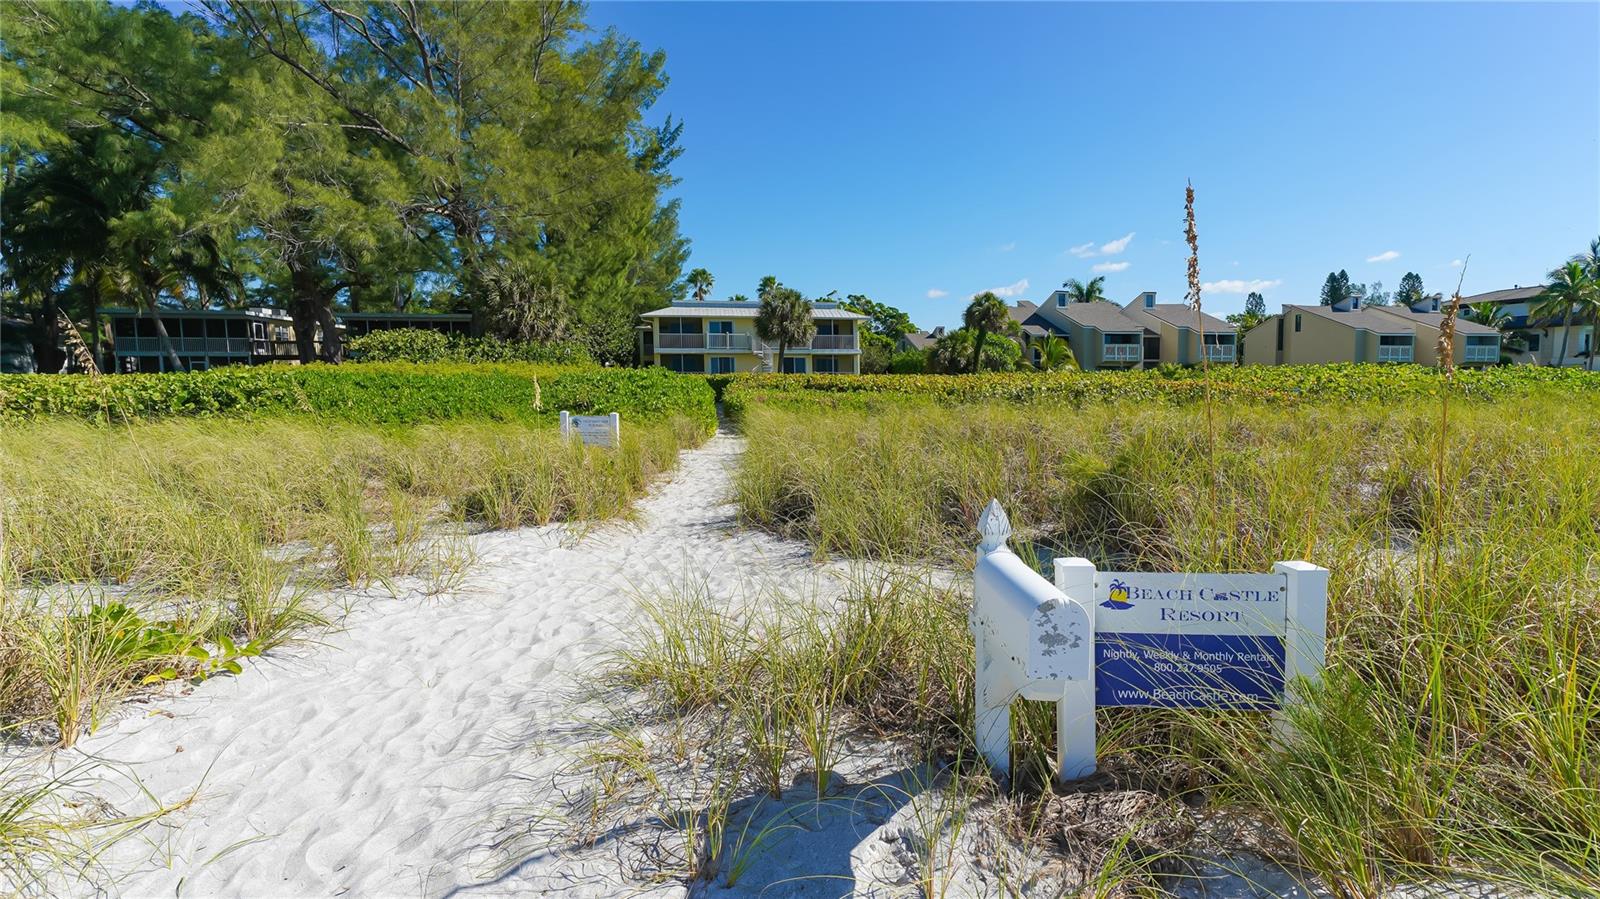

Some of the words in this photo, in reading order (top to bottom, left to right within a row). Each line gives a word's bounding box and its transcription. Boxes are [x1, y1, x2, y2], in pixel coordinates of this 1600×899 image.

[1126, 586, 1192, 601] BEACH
[1160, 607, 1241, 622] RESORT
[1103, 649, 1140, 661] Nightly,
[1182, 651, 1191, 660] &
[1194, 651, 1234, 663] Monthly
